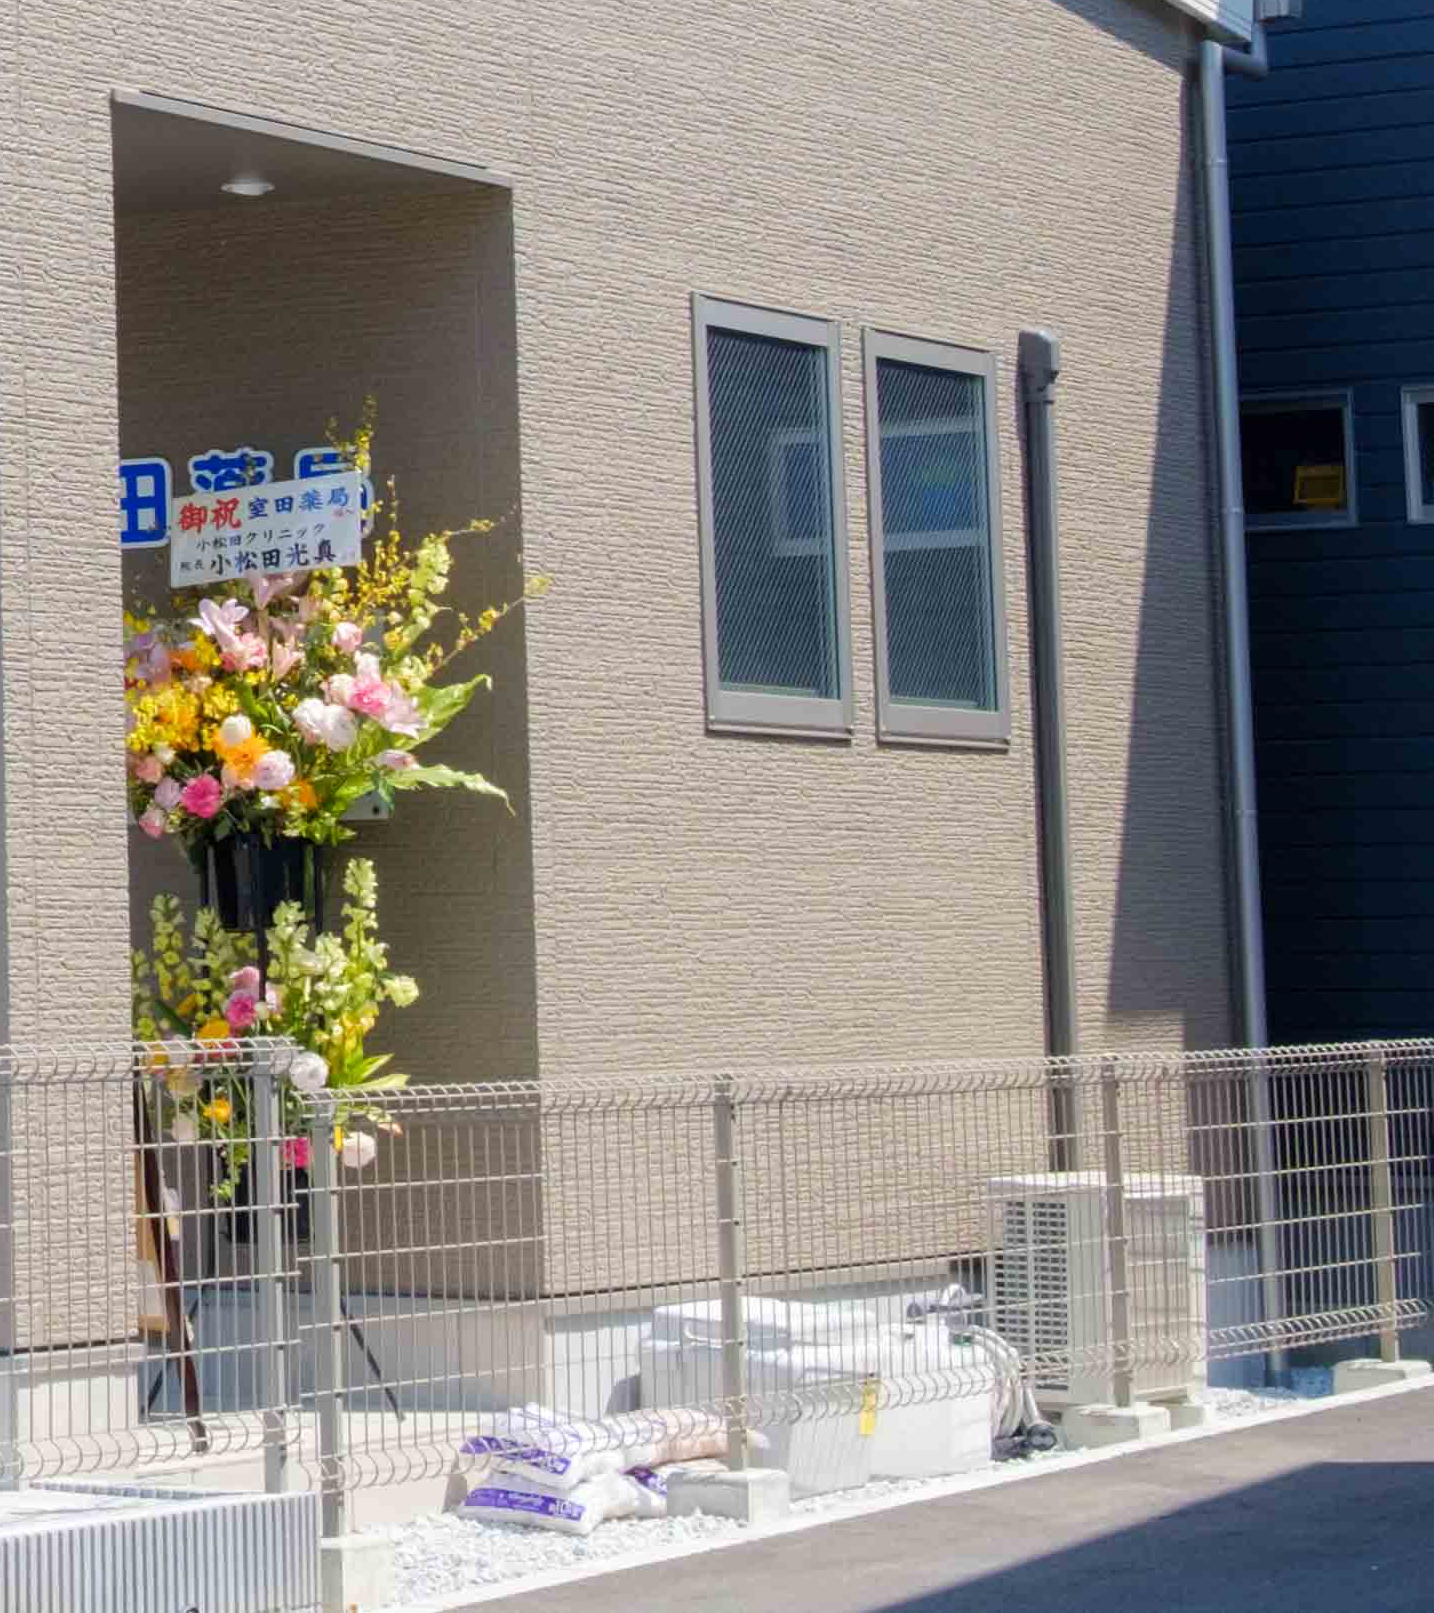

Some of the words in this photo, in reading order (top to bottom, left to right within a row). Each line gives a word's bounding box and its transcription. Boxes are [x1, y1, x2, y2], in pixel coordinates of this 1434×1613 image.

[178, 497, 242, 534] 御祝
[247, 487, 350, 520] 室田薬局
[210, 538, 337, 575] 小松田光真
